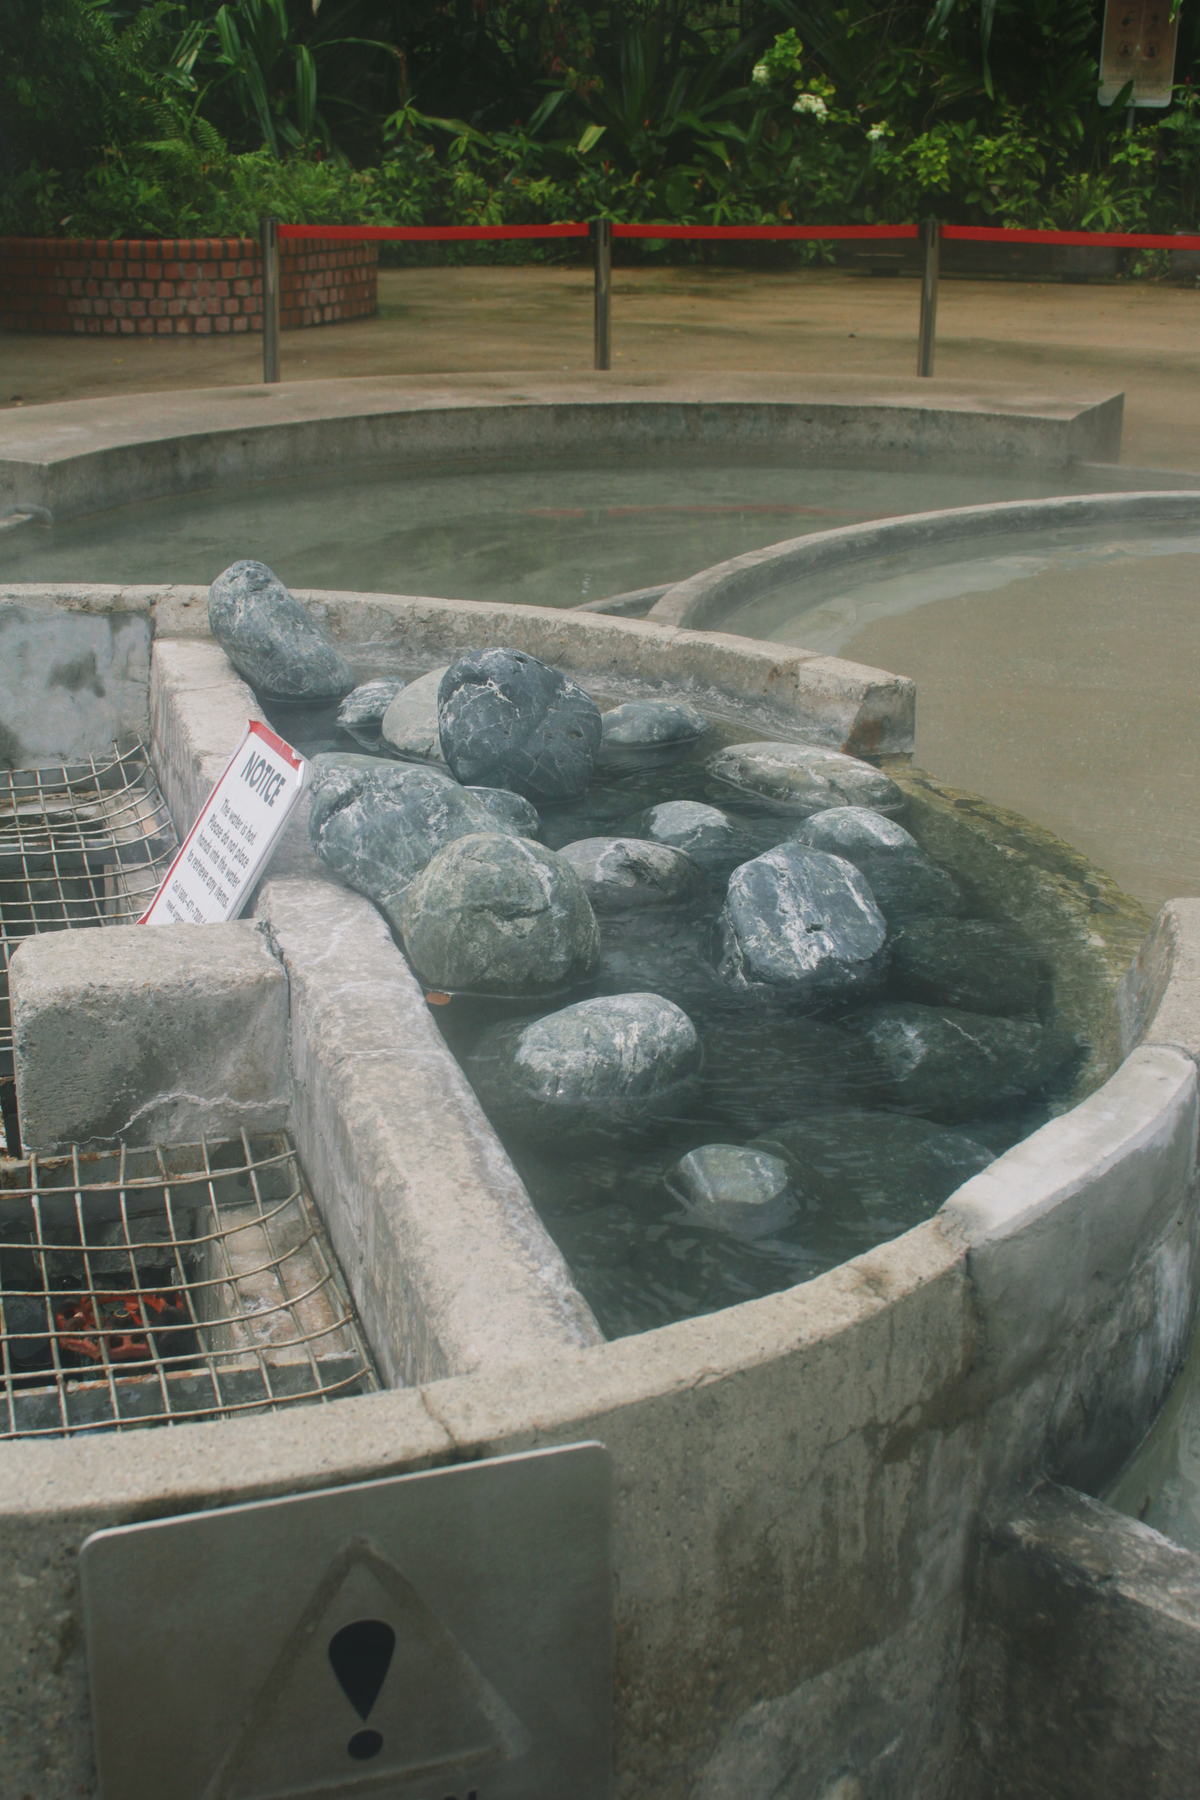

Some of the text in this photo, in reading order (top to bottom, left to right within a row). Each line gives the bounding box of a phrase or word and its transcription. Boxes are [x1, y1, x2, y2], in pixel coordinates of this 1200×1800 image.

[240, 750, 286, 807] NOTICE
[207, 813, 250, 869] Please do not place
[220, 798, 257, 846] The water is hot.
[172, 879, 181, 895] Call
[186, 848, 229, 910] to retrieve any items.
[196, 829, 240, 889] hands into the water
